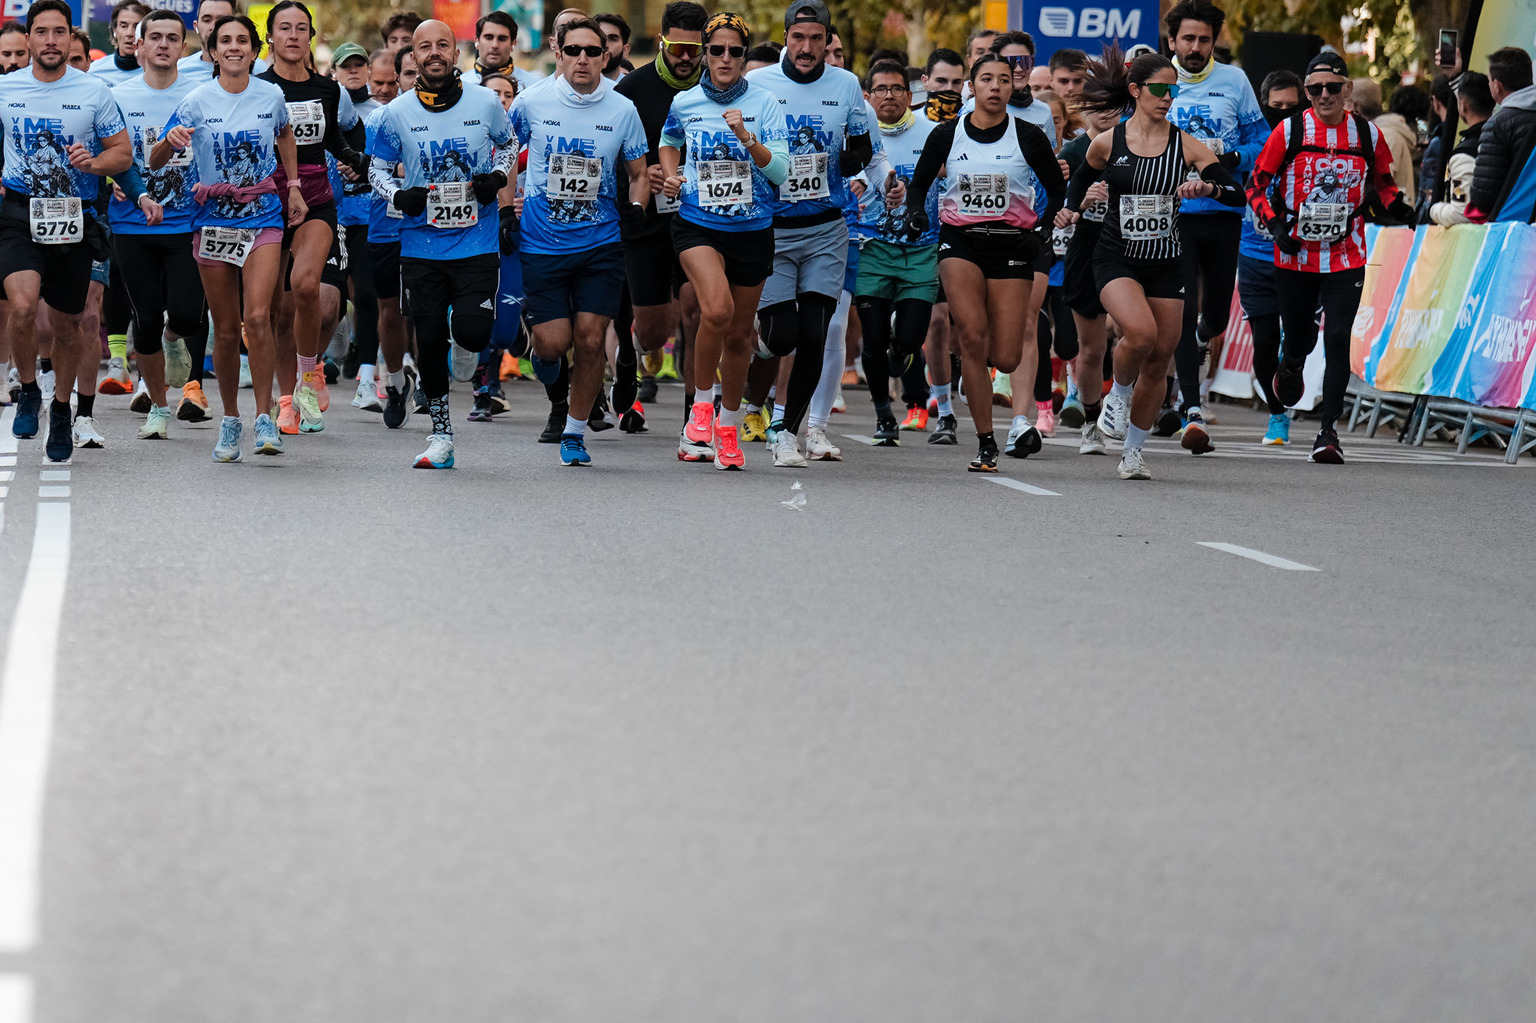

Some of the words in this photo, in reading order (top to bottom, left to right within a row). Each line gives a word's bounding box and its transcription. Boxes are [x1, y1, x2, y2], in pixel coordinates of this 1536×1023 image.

[1077, 8, 1141, 38] BM
[61, 103, 81, 111] MARCA
[291, 124, 319, 137] 631
[559, 178, 588, 193] 142
[707, 182, 743, 197] 1674
[788, 177, 820, 192] 340
[962, 194, 1005, 208] 9460
[434, 205, 472, 220] 2149
[36, 221, 77, 236] 5776
[1124, 217, 1168, 232] 4008
[1302, 222, 1340, 236] 6370
[205, 240, 245, 257] 5775
